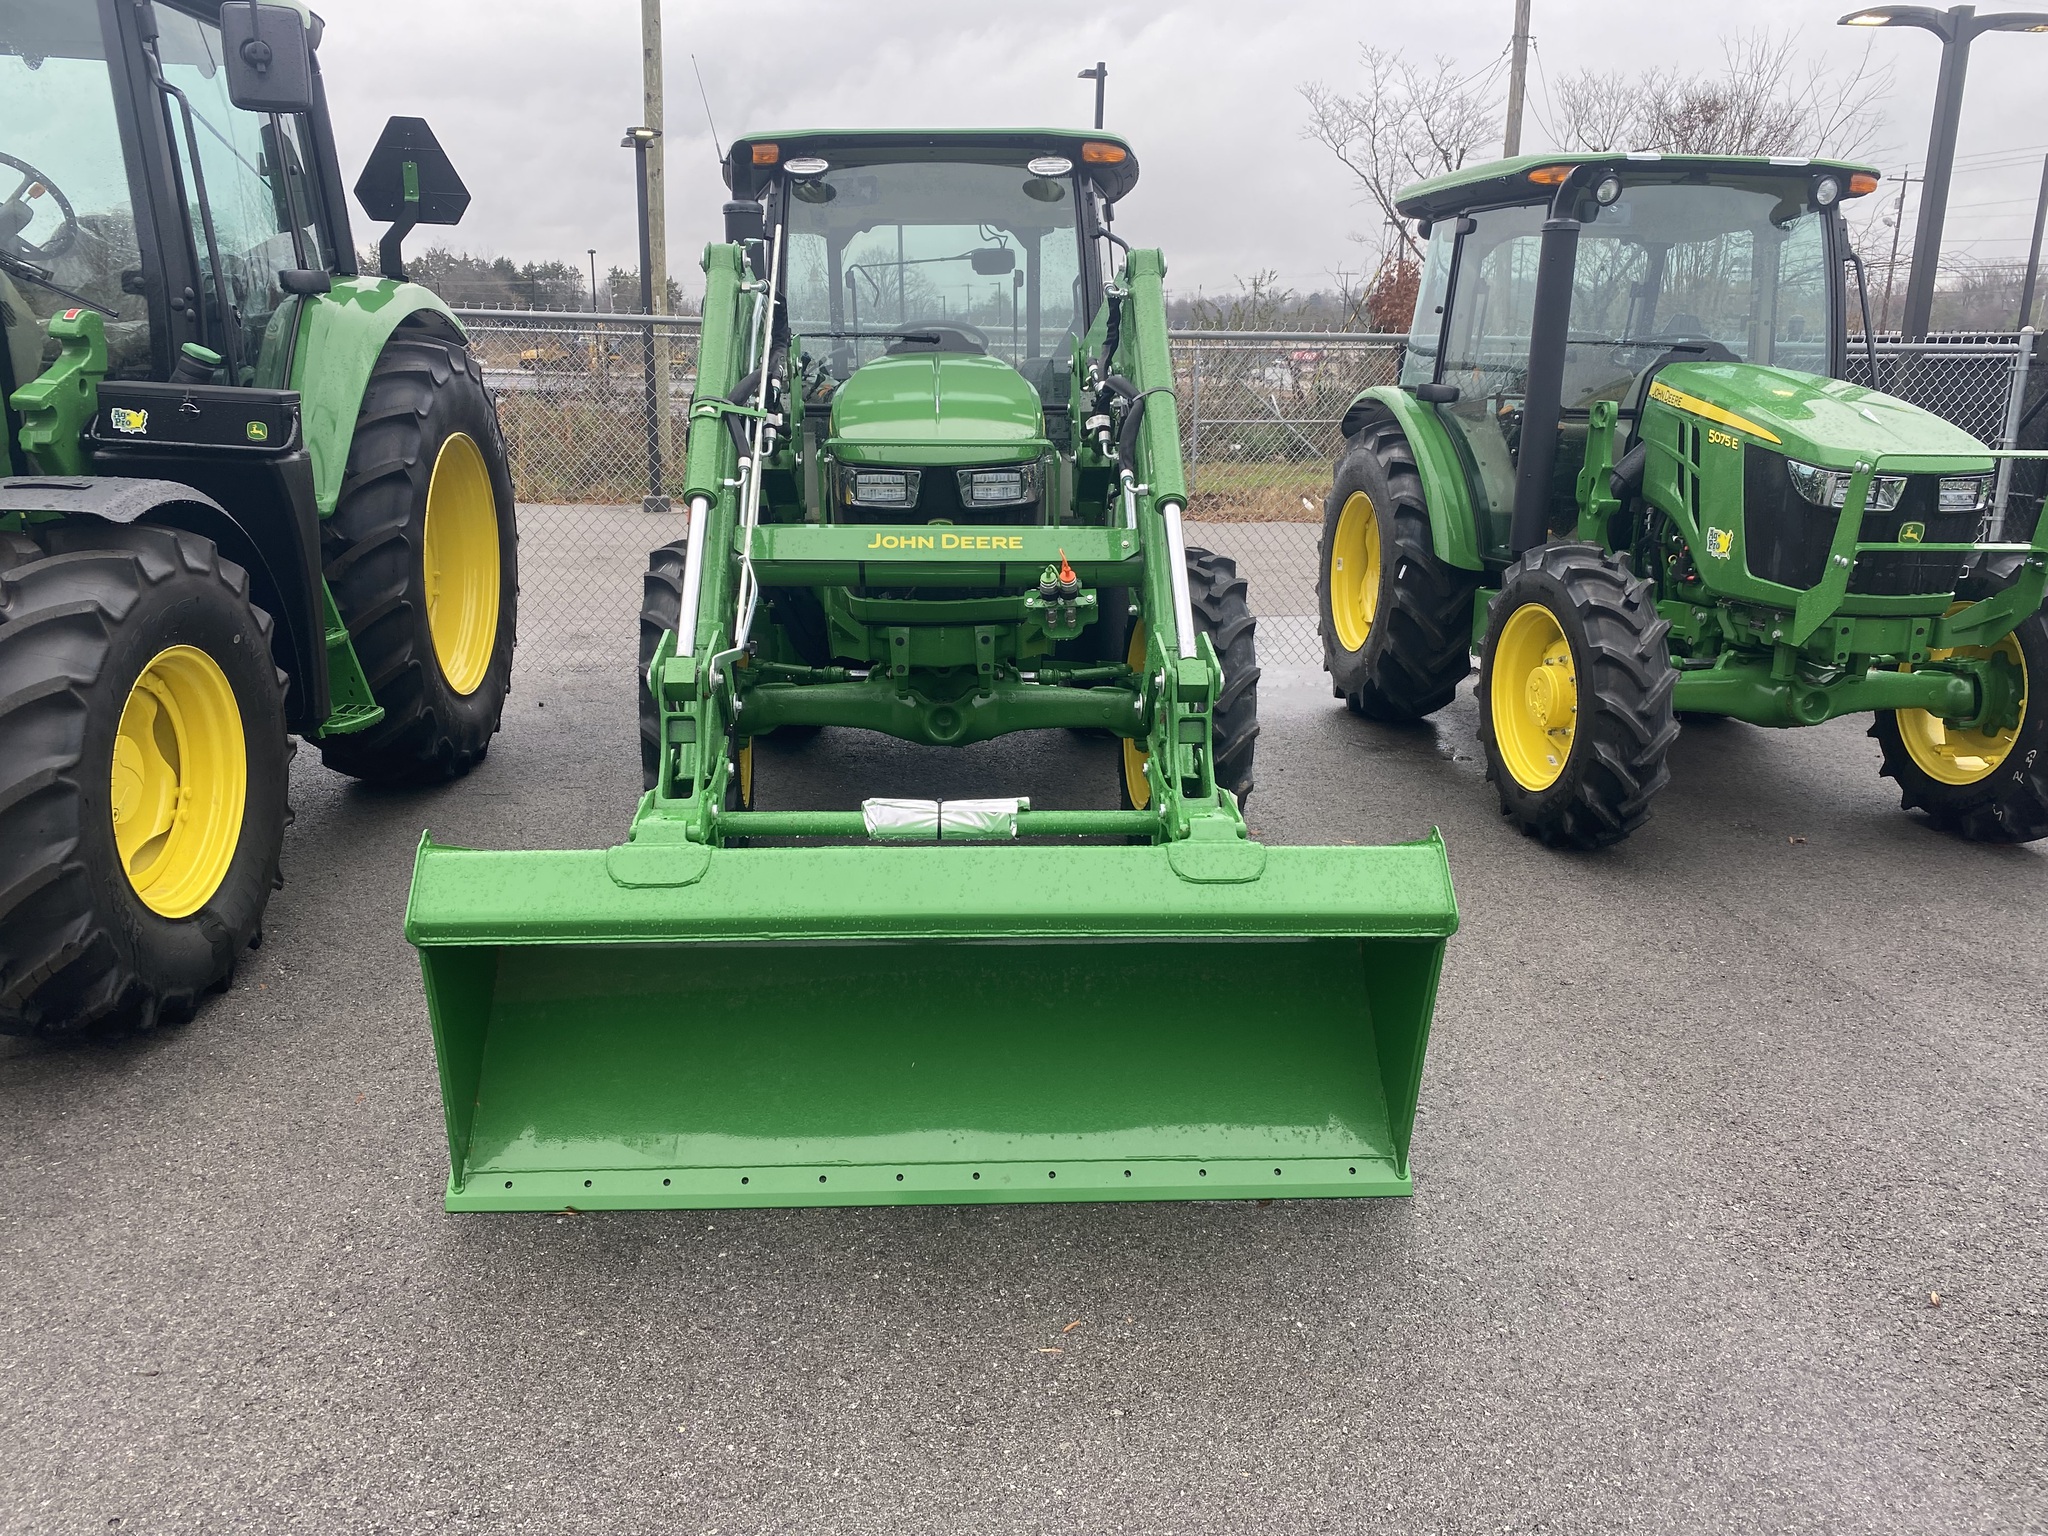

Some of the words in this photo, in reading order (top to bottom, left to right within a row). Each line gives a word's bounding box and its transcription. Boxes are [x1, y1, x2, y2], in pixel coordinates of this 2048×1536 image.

[1665, 390, 1683, 406] DEERE
[1708, 428, 1731, 447] 5075
[1731, 437, 1739, 450] E
[867, 533, 934, 549] JOHN
[941, 533, 1023, 549] DEERE
